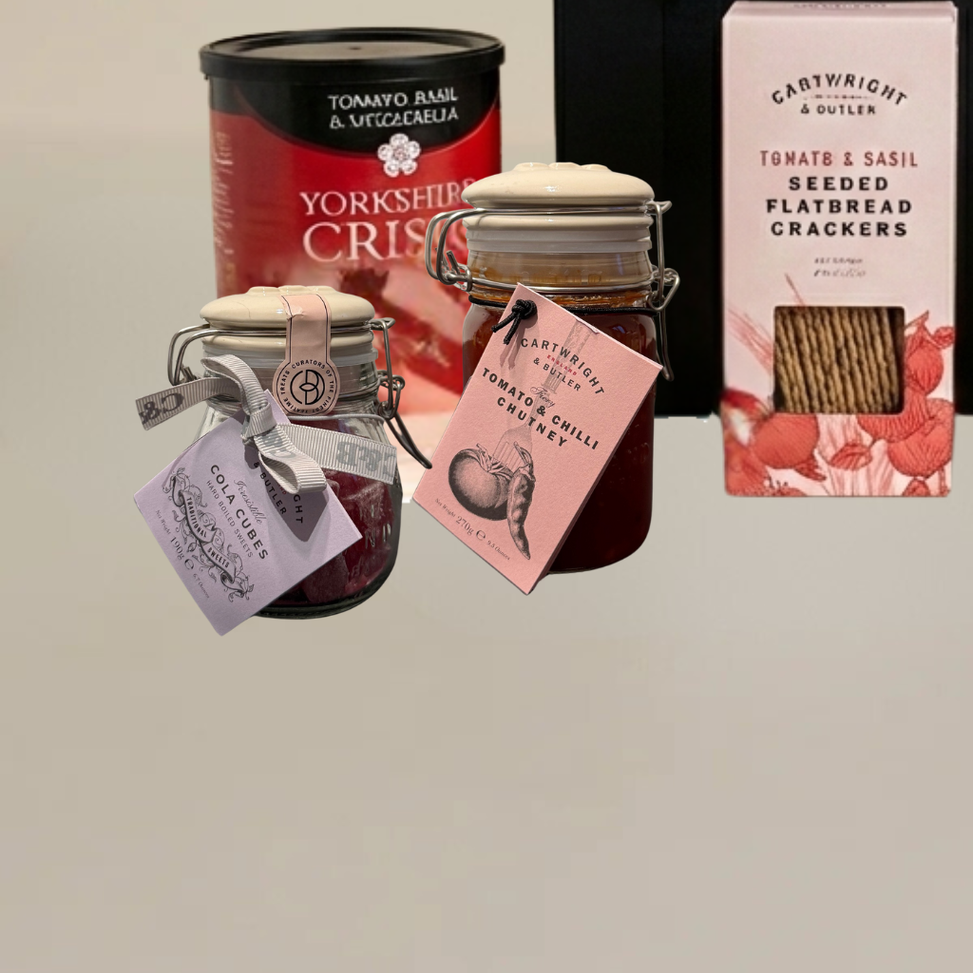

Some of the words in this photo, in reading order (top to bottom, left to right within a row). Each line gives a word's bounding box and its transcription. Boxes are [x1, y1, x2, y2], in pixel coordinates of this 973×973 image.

[771, 73, 908, 106] CARTWRIGHT
[801, 103, 810, 115] &
[843, 151, 854, 167] &
[788, 176, 888, 192] SEEDED
[766, 198, 912, 214] FLATBREAD
[770, 221, 907, 237] CRACKERS
[520, 337, 605, 395] CARTWRIGHT
[533, 357, 540, 366] &
[542, 363, 581, 391] BUTLER
[546, 354, 577, 376] ENGLAND
[482, 367, 533, 407] TOMATO
[536, 405, 546, 417] &
[551, 414, 599, 450] CHILLI
[497, 397, 568, 447] CHUTNEY
[259, 472, 287, 515] BUTLER
[206, 479, 220, 500] HARD
[218, 500, 236, 527] BOILED
[233, 528, 254, 558] SWEETS
[210, 464, 236, 505] COLA
[235, 508, 269, 560] CUBES
[455, 515, 475, 536] 270g
[186, 496, 207, 538] TRADITIONAL
[207, 547, 230, 568] SWEETS
